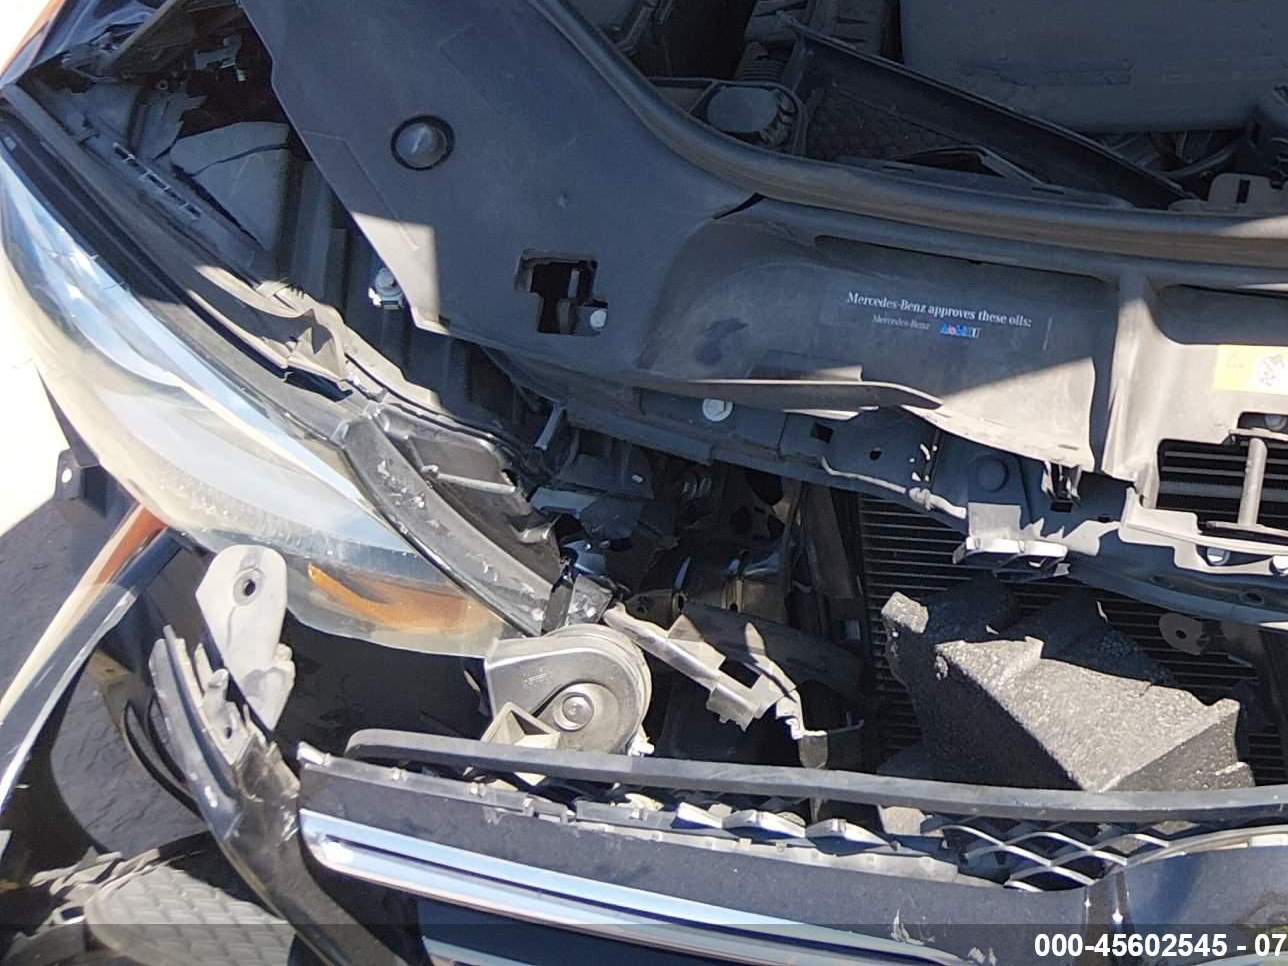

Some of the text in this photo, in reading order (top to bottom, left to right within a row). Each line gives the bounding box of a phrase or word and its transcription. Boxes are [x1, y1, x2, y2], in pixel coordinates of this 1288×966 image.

[847, 291, 927, 314] Mercedes-Benz
[928, 305, 975, 321] approves
[978, 310, 1006, 326] these
